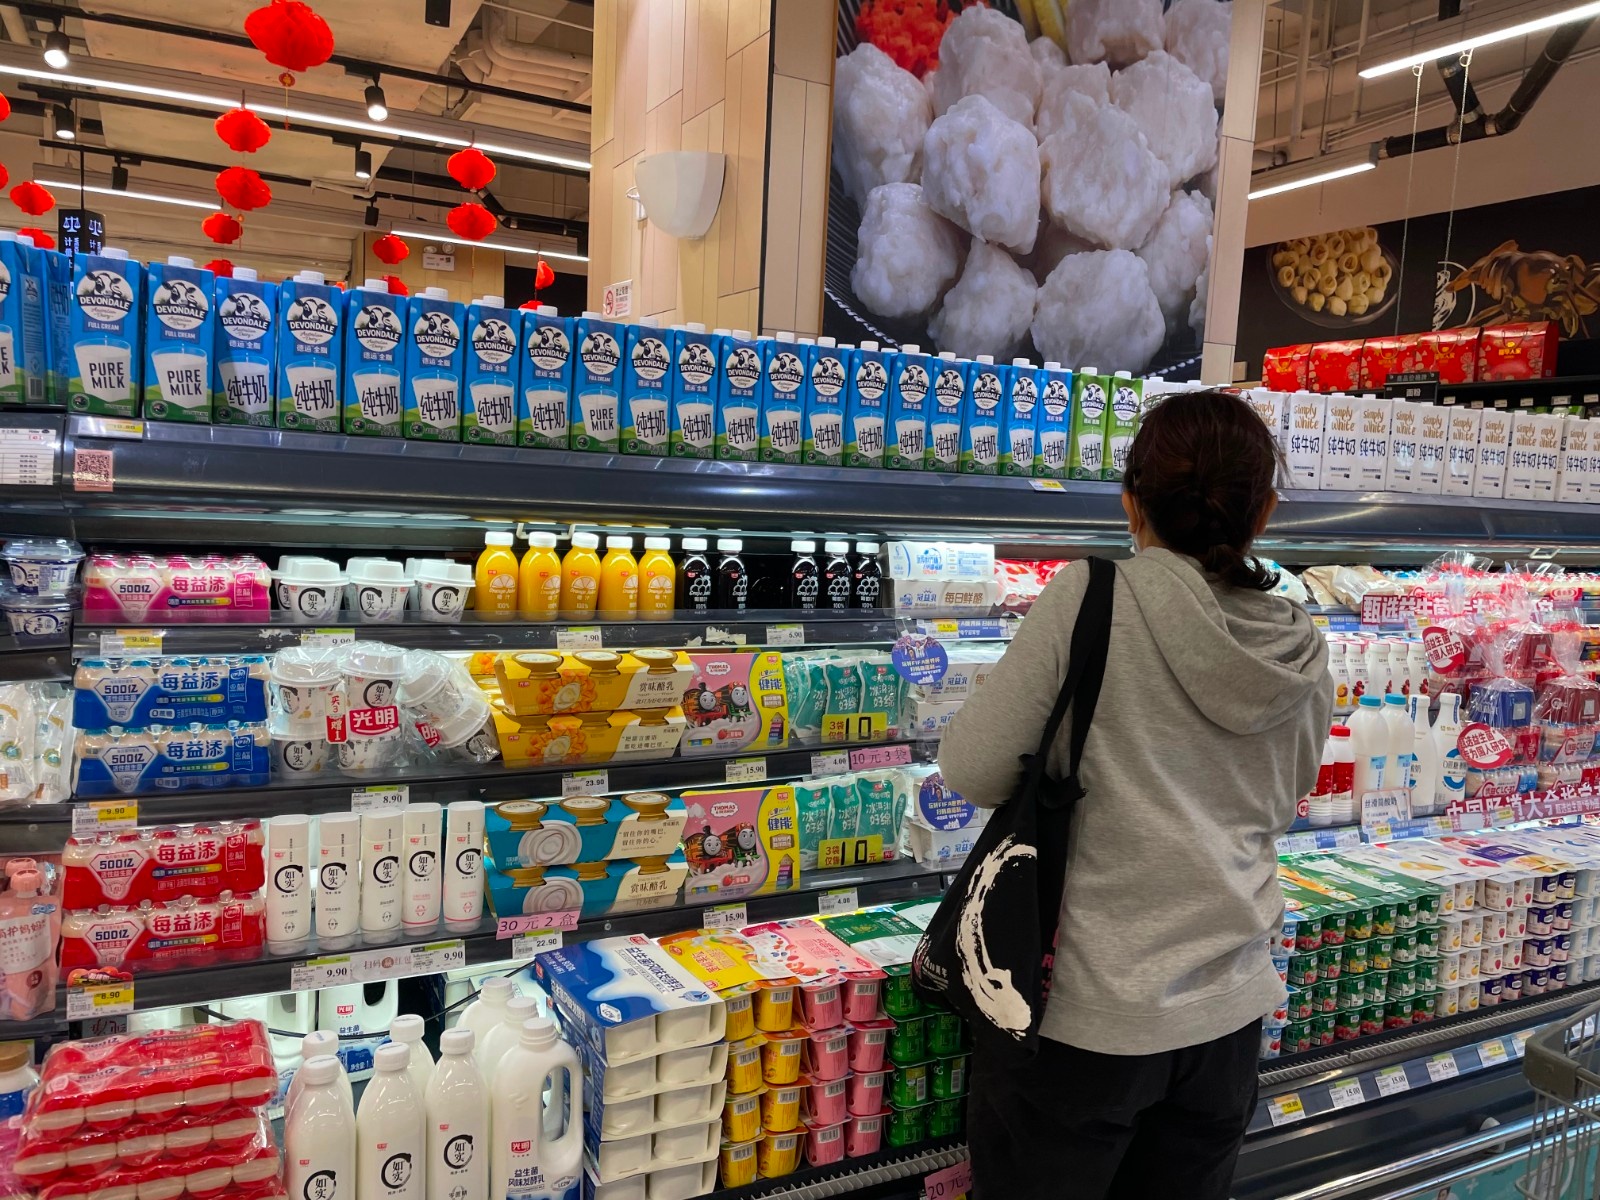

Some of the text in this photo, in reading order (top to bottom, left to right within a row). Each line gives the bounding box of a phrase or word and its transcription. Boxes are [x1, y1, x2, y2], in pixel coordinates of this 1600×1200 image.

[80, 296, 130, 312] DEVONDALE
[156, 305, 208, 322] DEVONDALE
[87, 322, 119, 332] FULL CREAM
[222, 316, 268, 330] DEVONDALE
[288, 320, 336, 334] DEVONDALE
[164, 330, 196, 340] FULL CREAM
[356, 328, 400, 343] DEVONDALE
[416, 335, 458, 347] DEVONDALE
[474, 341, 515, 353] DEVONDALE
[530, 348, 569, 360] DEVONDALE
[582, 352, 619, 365] DEVONDALE
[632, 358, 668, 370] DEVONDALE
[89, 362, 124, 376] PURE
[167, 369, 201, 384] PURE
[680, 364, 716, 375] DEVONDALE
[728, 368, 760, 379] DEVONDALE
[92, 376, 126, 390] MILK
[770, 372, 802, 383] DEVONDALE
[811, 375, 844, 387] DEVONDALE
[170, 383, 202, 396] MILK
[228, 374, 267, 405] 纯牛奶
[294, 379, 334, 411] 纯牛奶
[362, 386, 399, 417] 纯牛奶
[420, 390, 456, 422] 纯牛奶
[478, 395, 512, 426] 纯牛奶
[533, 400, 565, 431] 纯牛奶
[589, 408, 614, 420] PURE
[1294, 404, 1317, 419] simply
[1331, 406, 1353, 423] simply
[1363, 408, 1384, 423] simply
[1396, 410, 1414, 425] simply
[592, 419, 614, 432] MILK
[636, 409, 666, 438] 纯牛奶
[683, 411, 711, 440] 纯牛奶
[728, 416, 756, 444] 纯牛奶
[771, 419, 799, 445] 纯牛奶
[815, 422, 840, 451] 纯牛奶
[859, 426, 882, 453] 纯牛奶
[1291, 435, 1319, 454] 纯牛奶
[1328, 438, 1356, 456] 纯牛奶
[1360, 439, 1386, 457] 纯牛奶
[1393, 441, 1416, 458] 纯牛奶
[1419, 444, 1443, 461] 纯牛奶
[120, 584, 151, 593] 500亿
[172, 576, 226, 593] 每益添
[308, 592, 317, 610] 如实
[366, 592, 375, 610] 如实
[442, 590, 452, 608] 如实
[916, 593, 936, 602] 冠益乳
[945, 592, 983, 604] 每日鲜酪
[584, 634, 599, 642] 7.90
[161, 671, 220, 690] 每益添
[759, 678, 782, 690] 健能
[947, 676, 967, 685] 冠益乳
[104, 684, 138, 694] 500亿
[374, 685, 384, 702] 如实
[353, 708, 395, 728] 光明
[873, 730, 881, 739] 元
[166, 740, 224, 760] 每益添
[293, 747, 303, 762] 如实
[852, 748, 907, 764] 10 元 3 袋
[111, 753, 144, 764] 500亿
[746, 766, 764, 774] 15.90
[383, 795, 402, 804] 8.90
[768, 816, 793, 831] 健能
[157, 841, 217, 862] 每益添
[869, 853, 877, 862] 元
[99, 858, 134, 870] 500亿
[419, 856, 428, 872] 如实
[466, 854, 475, 870] 如实
[328, 868, 339, 885] 如实
[382, 862, 393, 879] 如实
[284, 870, 295, 888] 如实
[152, 911, 212, 934] 每益添
[499, 913, 574, 932] 30 元 2 盒
[725, 912, 744, 922] 15.90
[95, 929, 129, 941] 500亿
[536, 938, 557, 947] 22.90
[444, 951, 463, 961] 9.90
[327, 967, 347, 978] 9.90
[339, 1025, 360, 1033] 益生菌
[1441, 1062, 1454, 1070] 15.00
[1392, 1076, 1405, 1084] 15.00
[1346, 1088, 1360, 1097] 15.00
[454, 1143, 465, 1162] 如实
[512, 1142, 530, 1150] 光明
[392, 1161, 403, 1182] 如实
[514, 1167, 538, 1178] 益生菌
[508, 1174, 545, 1187] 风味发酵乳
[315, 1178, 326, 1200] 如实
